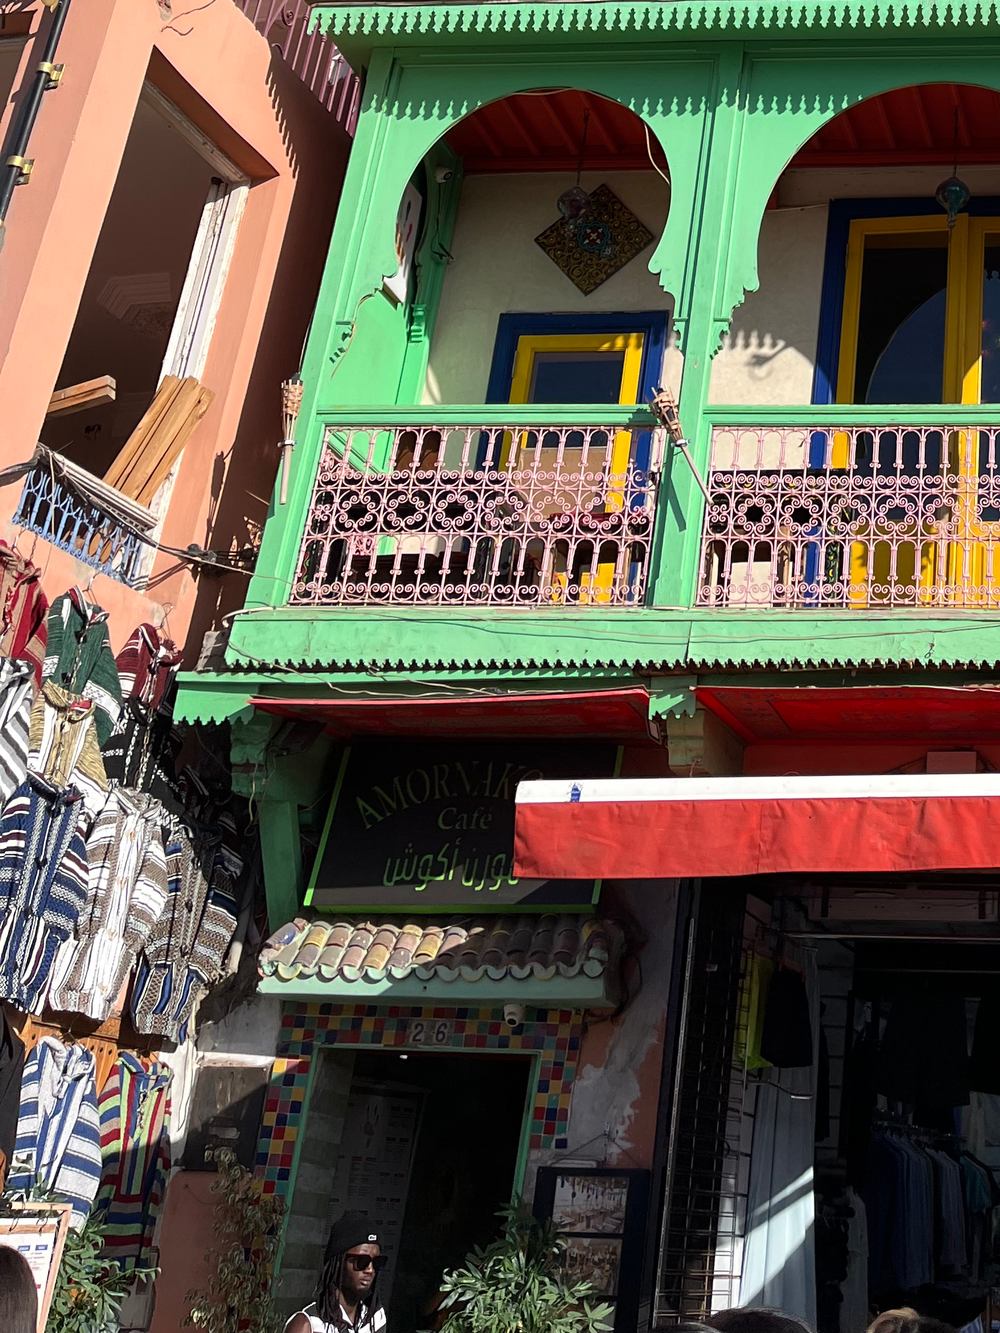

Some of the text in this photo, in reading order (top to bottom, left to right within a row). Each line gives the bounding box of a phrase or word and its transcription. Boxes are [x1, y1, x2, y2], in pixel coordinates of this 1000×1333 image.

[355, 760, 544, 830] AMORNAK
[437, 805, 493, 830] Café
[412, 1022, 448, 1043] 26
